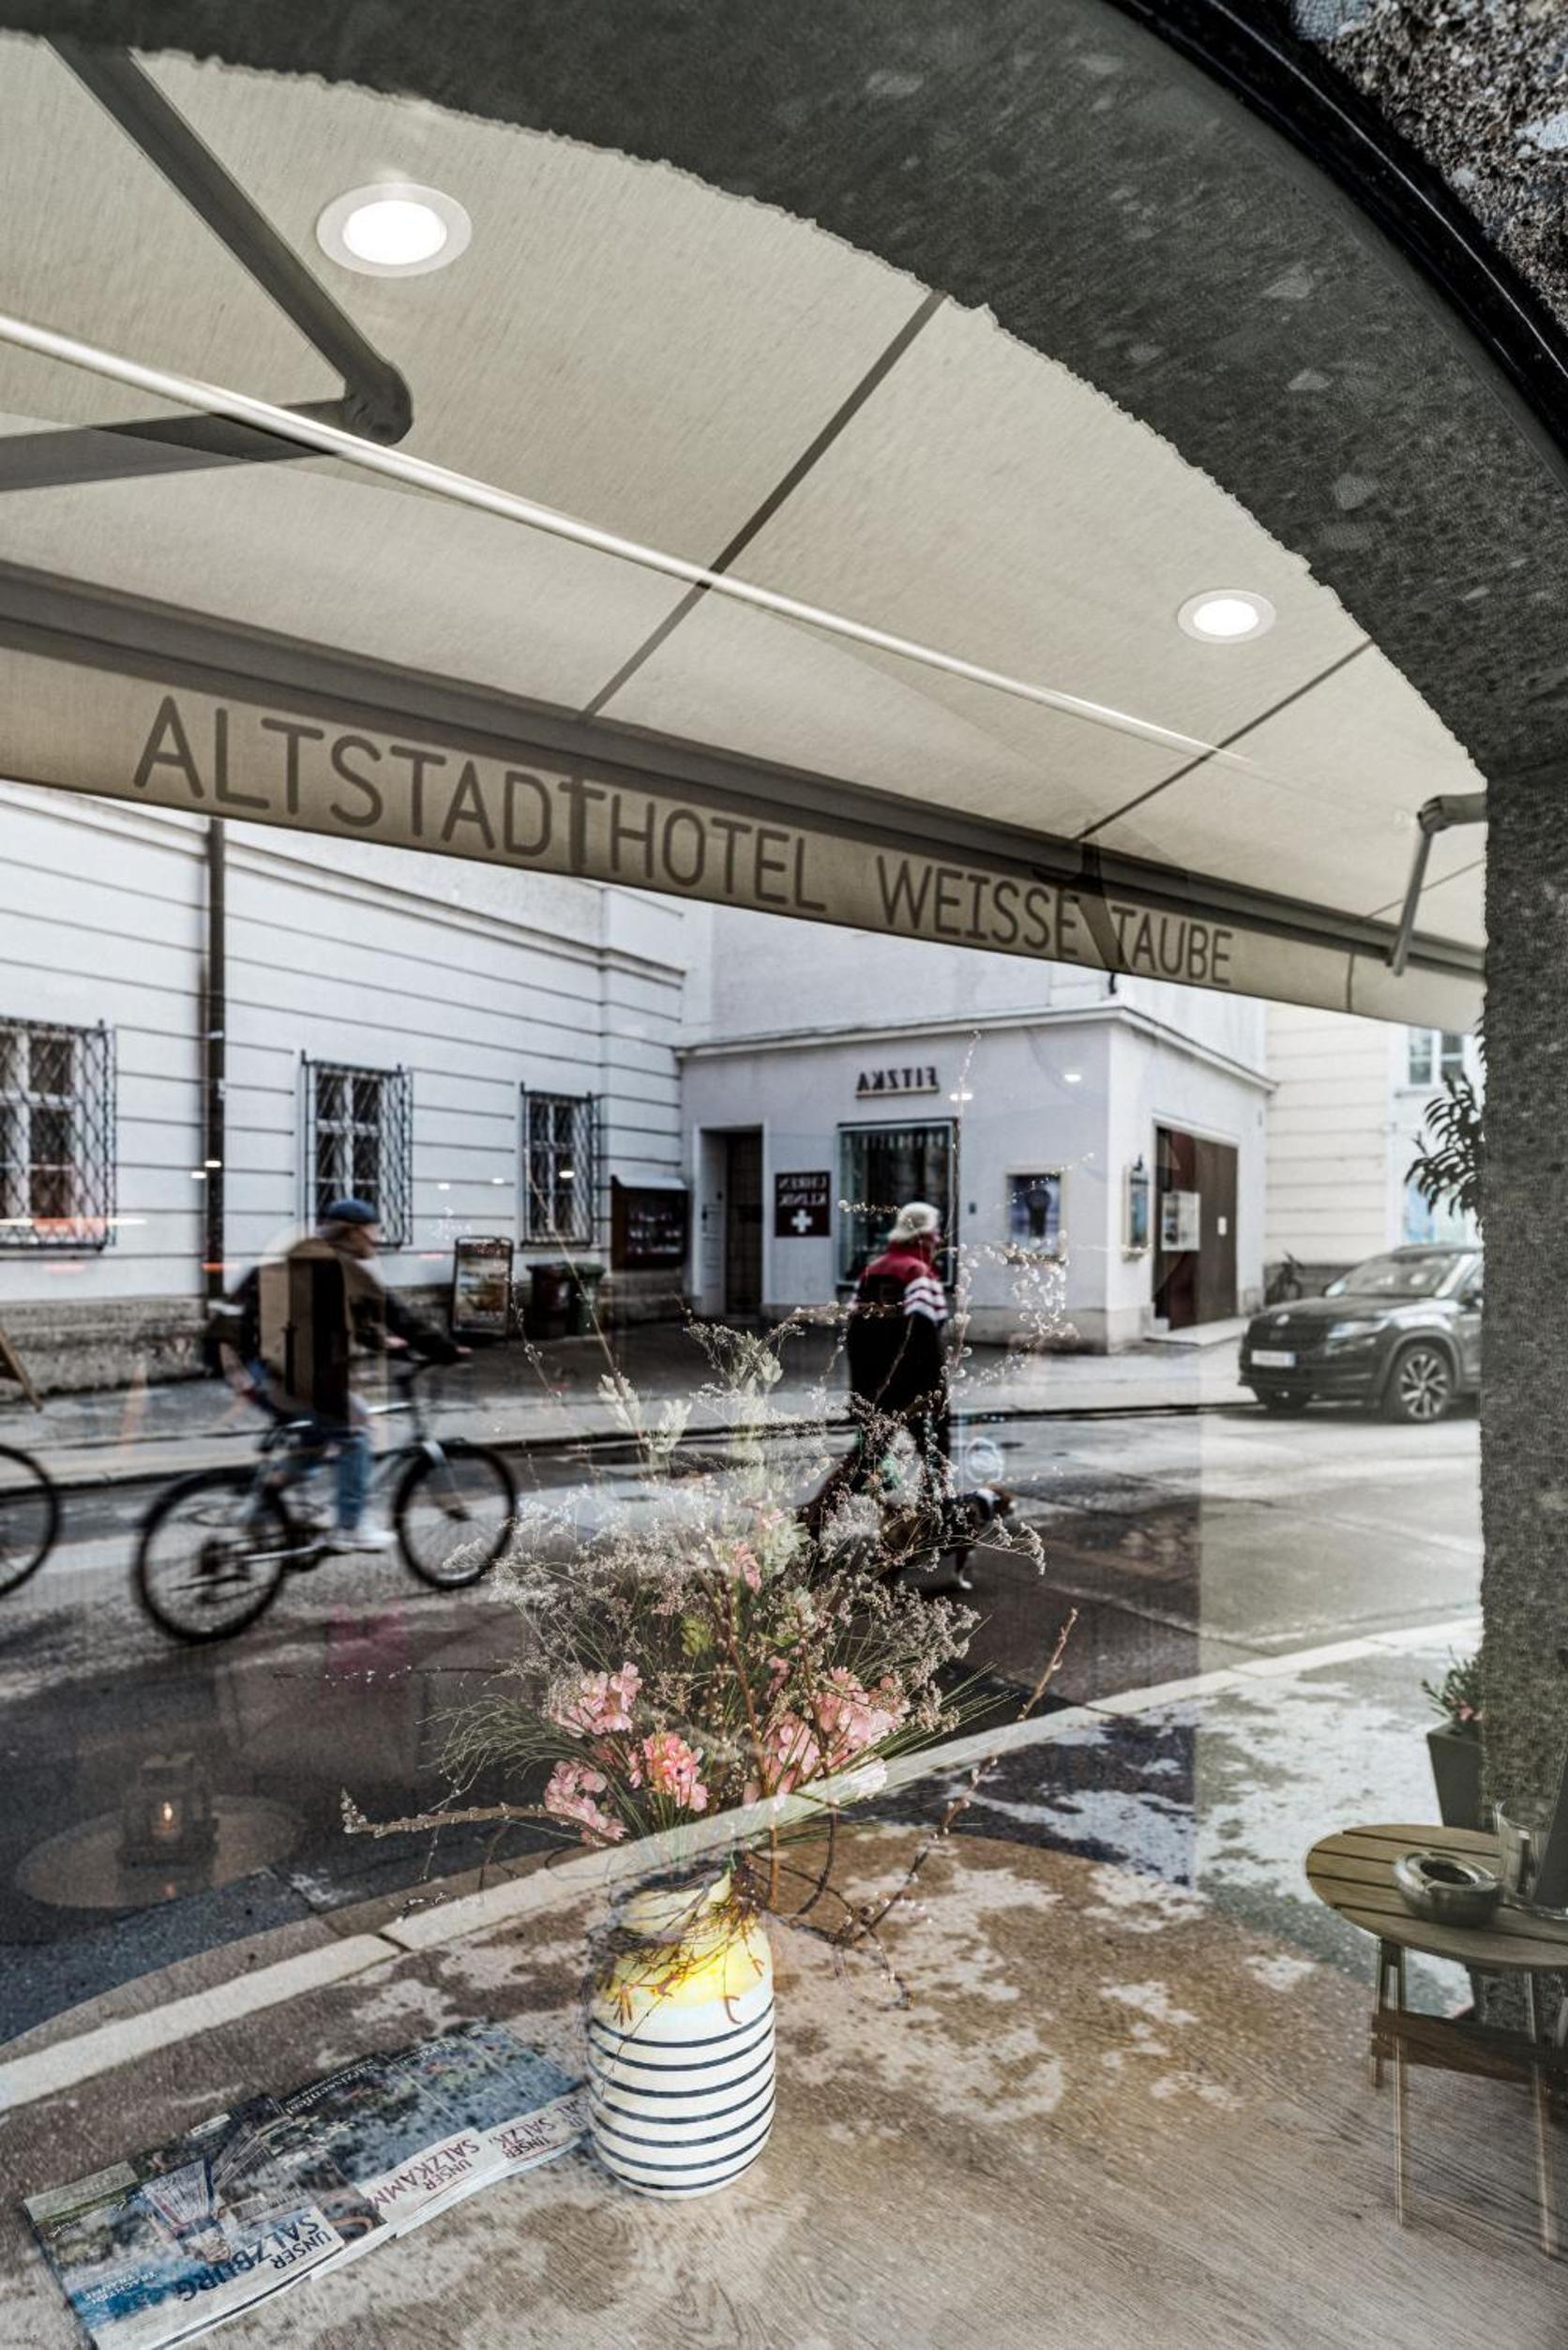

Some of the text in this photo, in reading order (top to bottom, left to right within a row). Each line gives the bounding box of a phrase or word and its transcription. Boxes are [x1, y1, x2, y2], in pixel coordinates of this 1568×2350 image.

[876, 854, 1080, 957] WEISSE
[1110, 904, 1235, 986] TAUBE
[424, 2159, 473, 2192] UNSER
[174, 2213, 320, 2302] SALZBURG
[270, 2230, 332, 2270] UNSER
